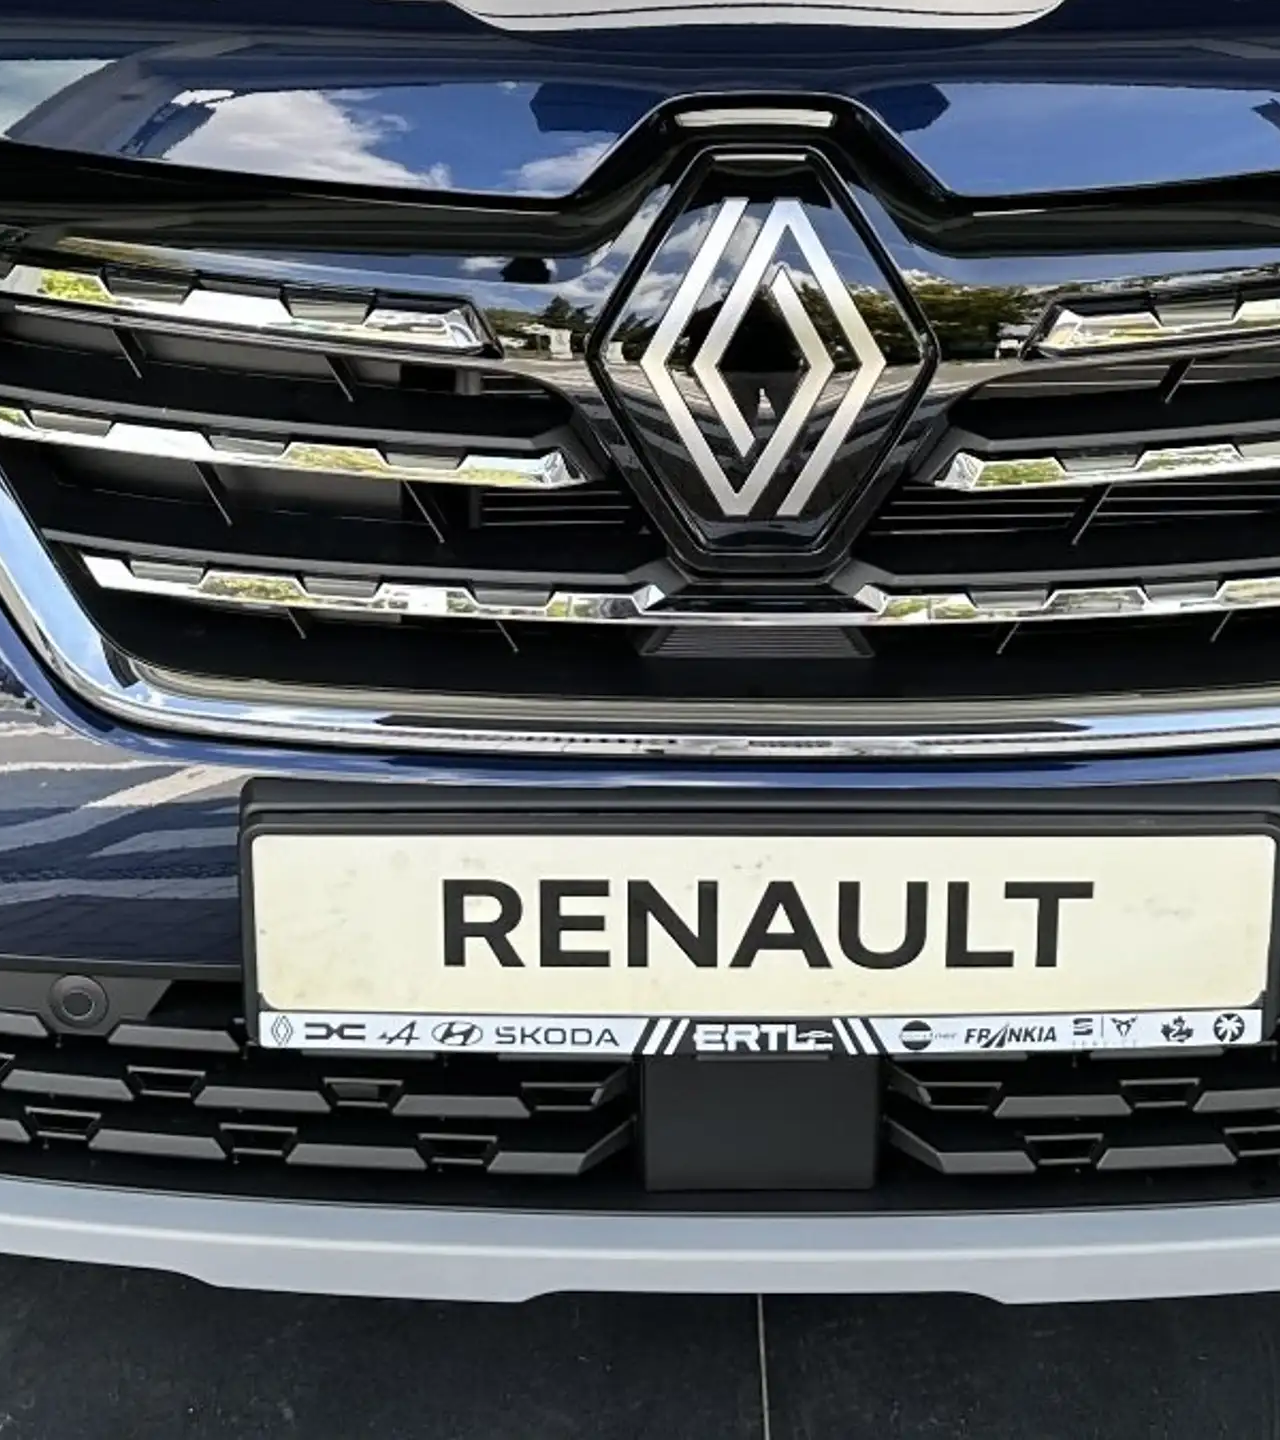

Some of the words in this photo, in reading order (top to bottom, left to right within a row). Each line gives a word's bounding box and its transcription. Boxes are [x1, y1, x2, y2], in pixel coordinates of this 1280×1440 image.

[443, 879, 1094, 969] RENAULT
[495, 1026, 620, 1046] SKODA
[693, 1023, 833, 1052] ERTL
[964, 1022, 1057, 1048] FRANKIA
